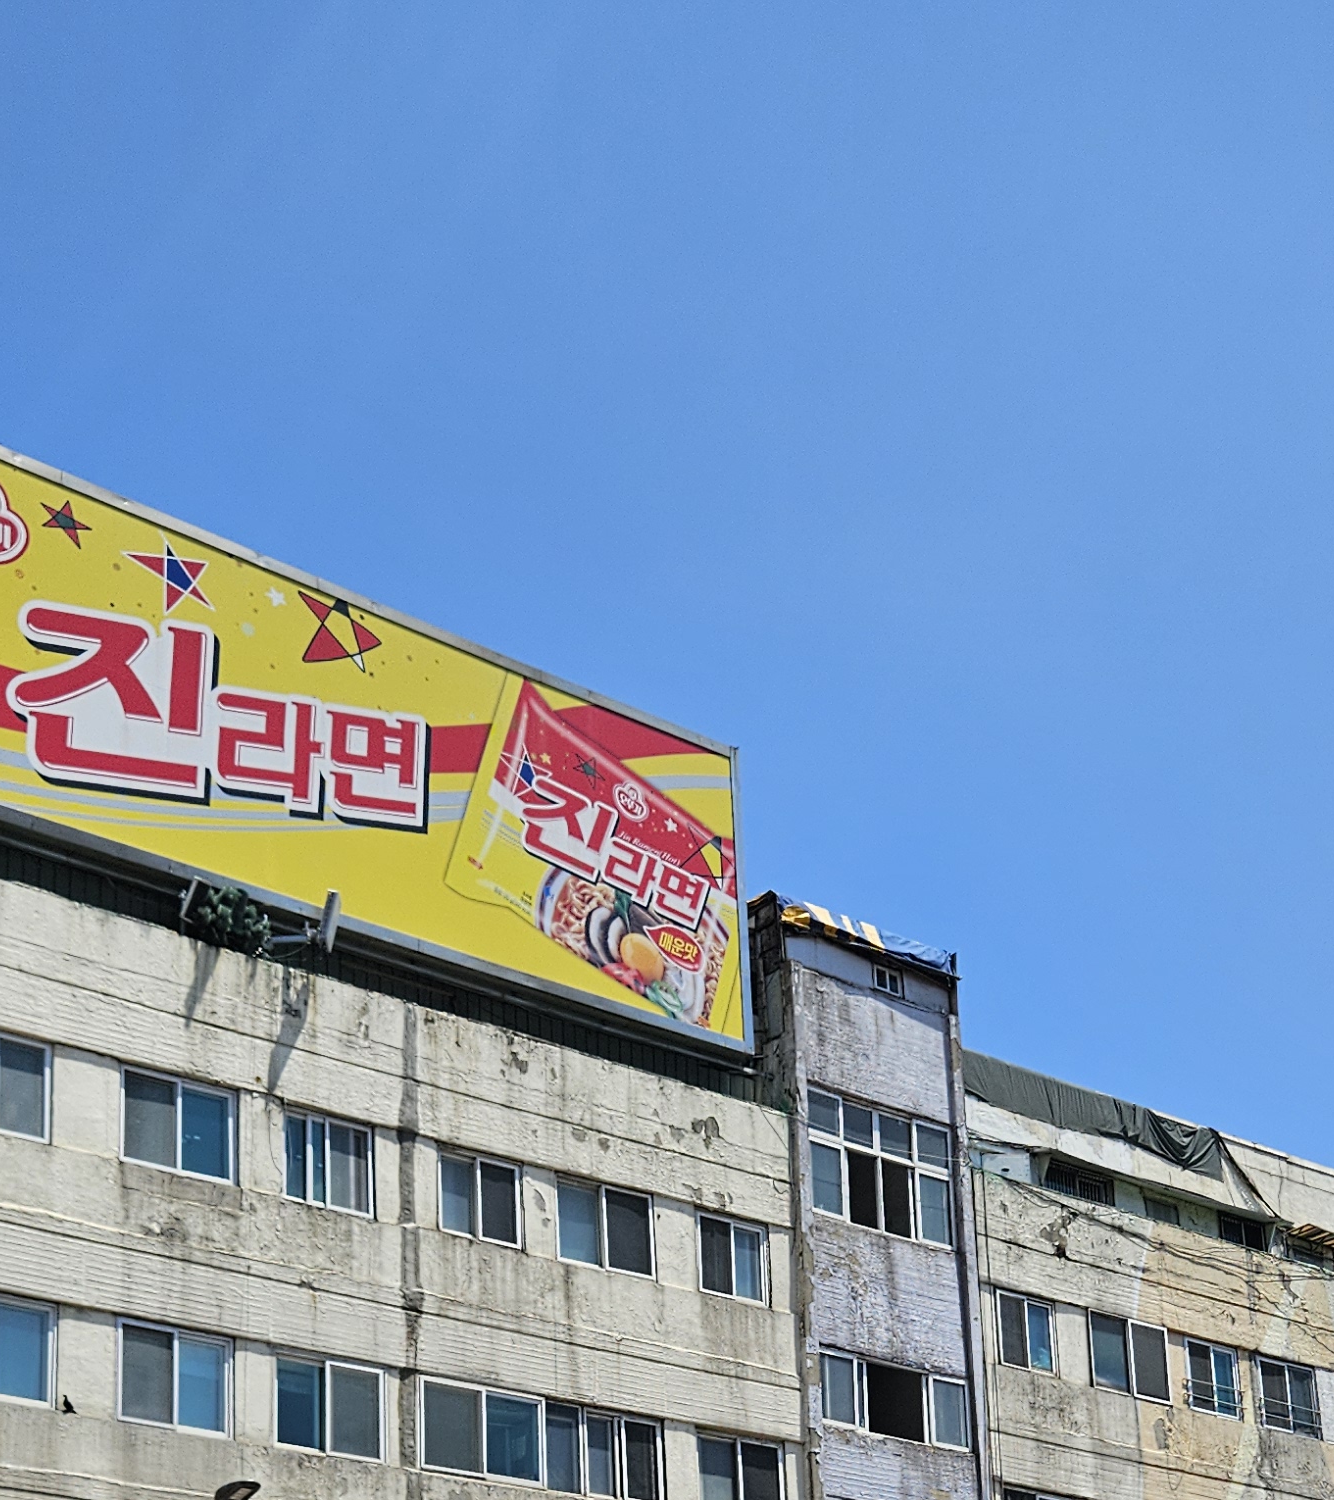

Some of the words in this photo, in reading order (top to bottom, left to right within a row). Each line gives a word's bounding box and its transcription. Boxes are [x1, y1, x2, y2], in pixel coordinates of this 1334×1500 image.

[11, 603, 424, 826] 진라면
[522, 779, 708, 930] 진라면
[658, 931, 699, 963] 매운맛
